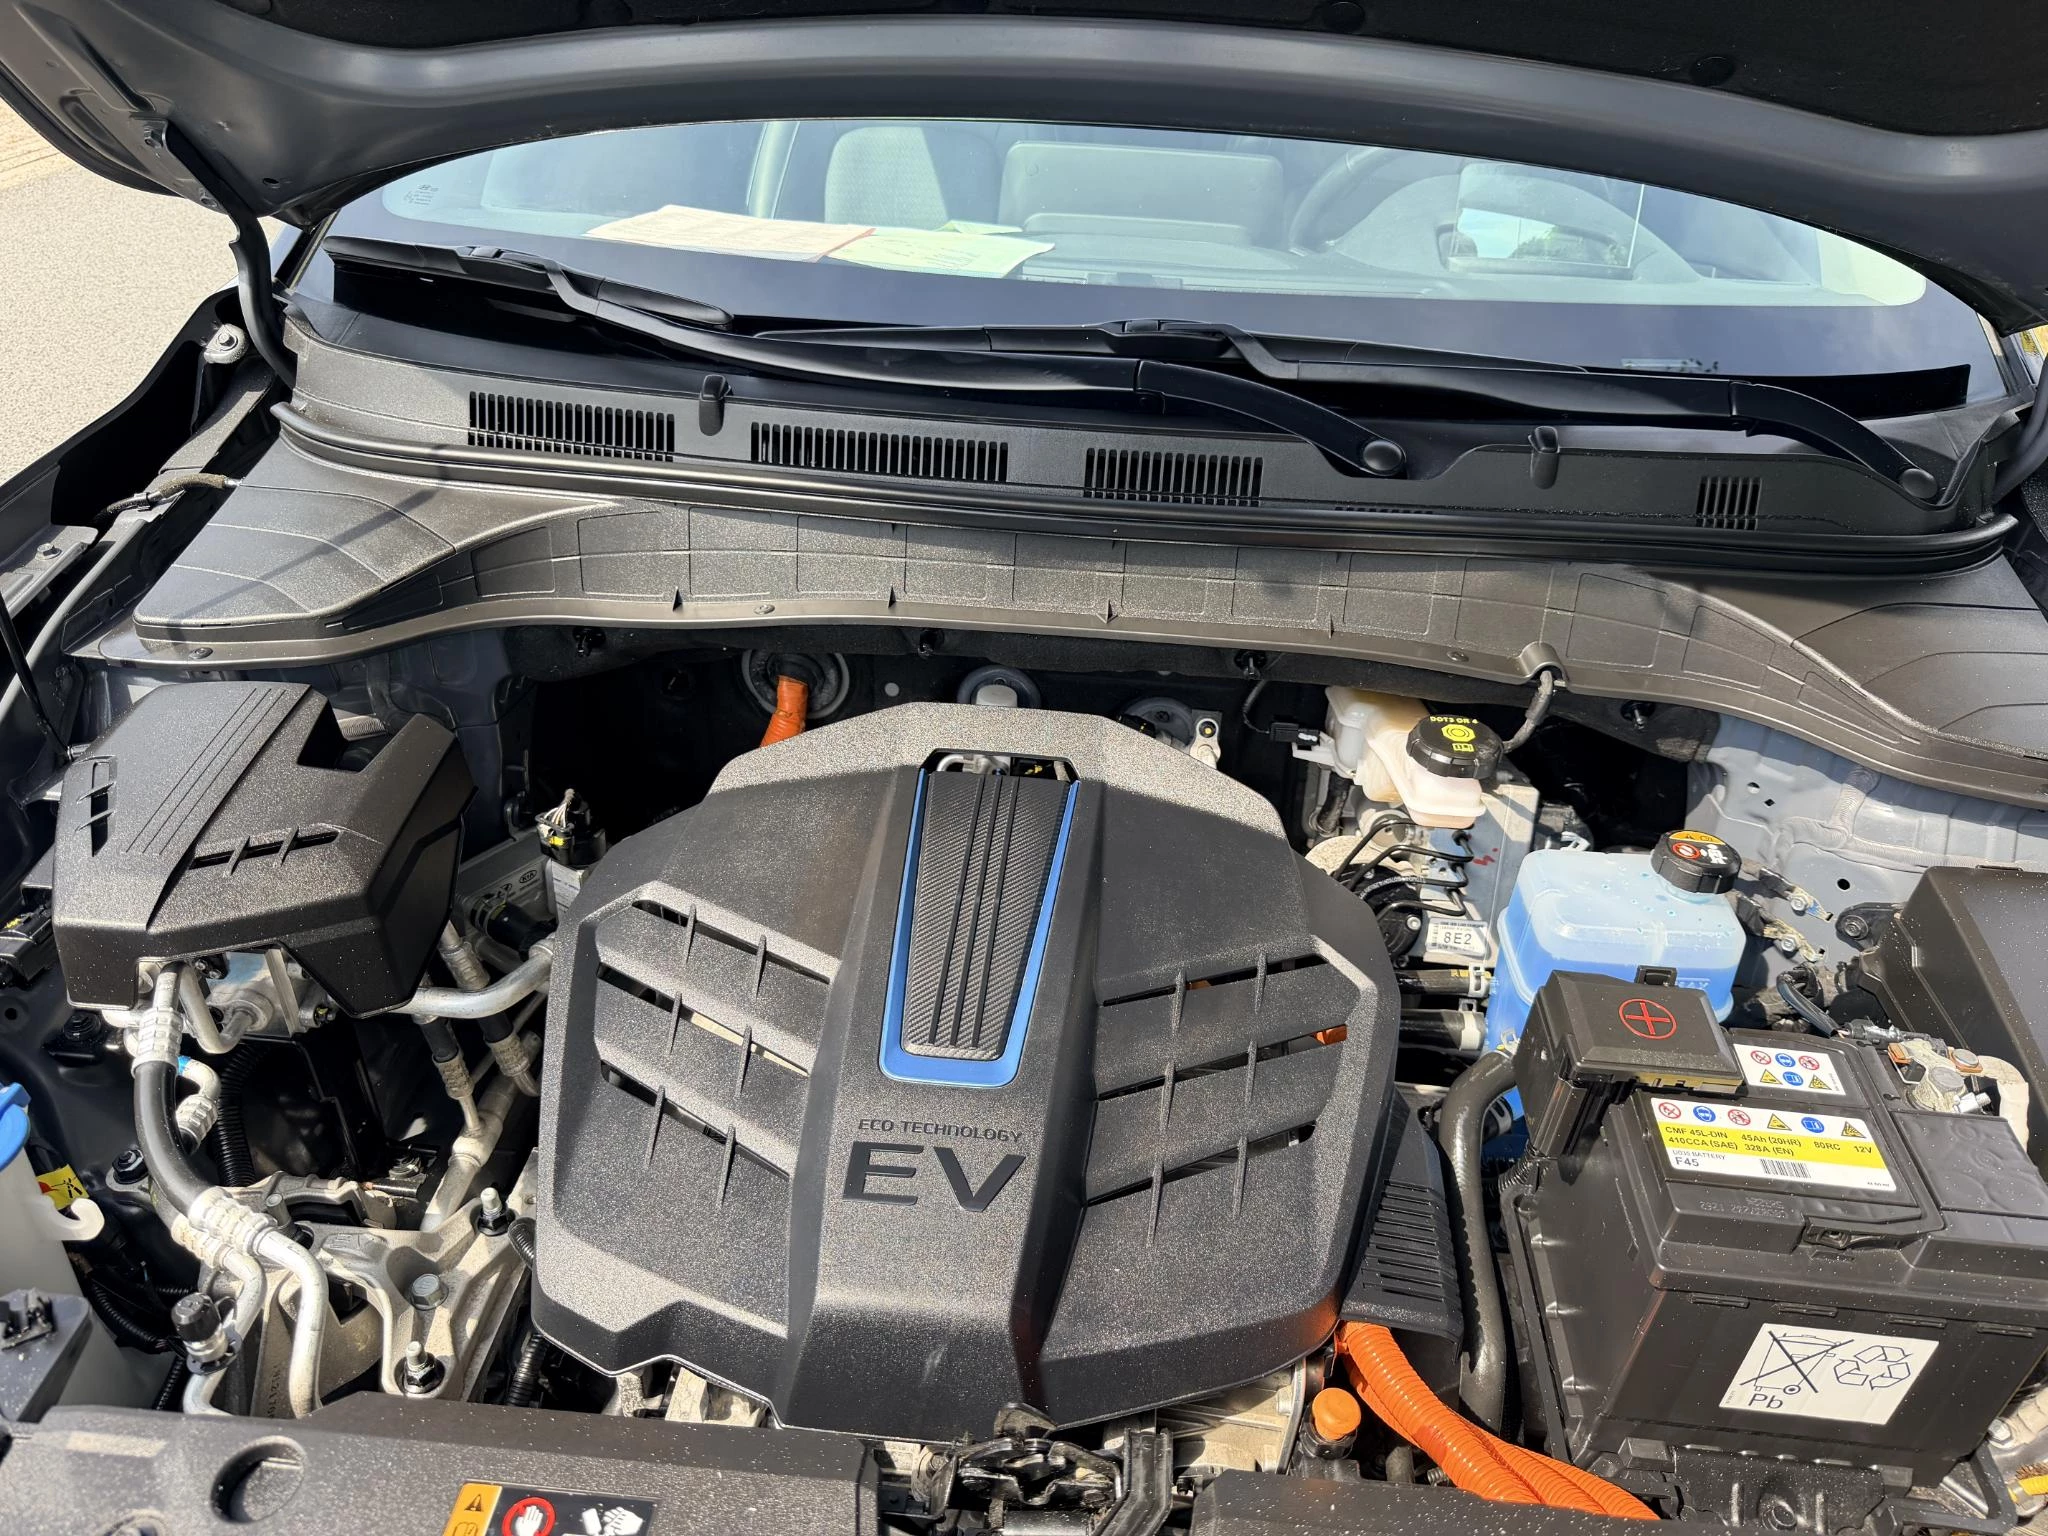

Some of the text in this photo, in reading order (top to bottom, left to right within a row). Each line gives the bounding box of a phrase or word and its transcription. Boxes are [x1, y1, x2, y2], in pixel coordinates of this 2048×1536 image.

[1443, 931, 1472, 945] 8E2
[858, 1118, 1023, 1143] ECO TECHNOLOGY
[1665, 1126, 1873, 1154] CMF 45L-DIN 45Ah (20HR) 80RC 12V
[1668, 1136, 1795, 1157] 410CCA (SAE) 328A (EN)
[1692, 1151, 1726, 1160] BATTERY
[1675, 1156, 1700, 1167] F45
[843, 1141, 1027, 1213] EV
[1748, 1393, 1784, 1410] Pb
